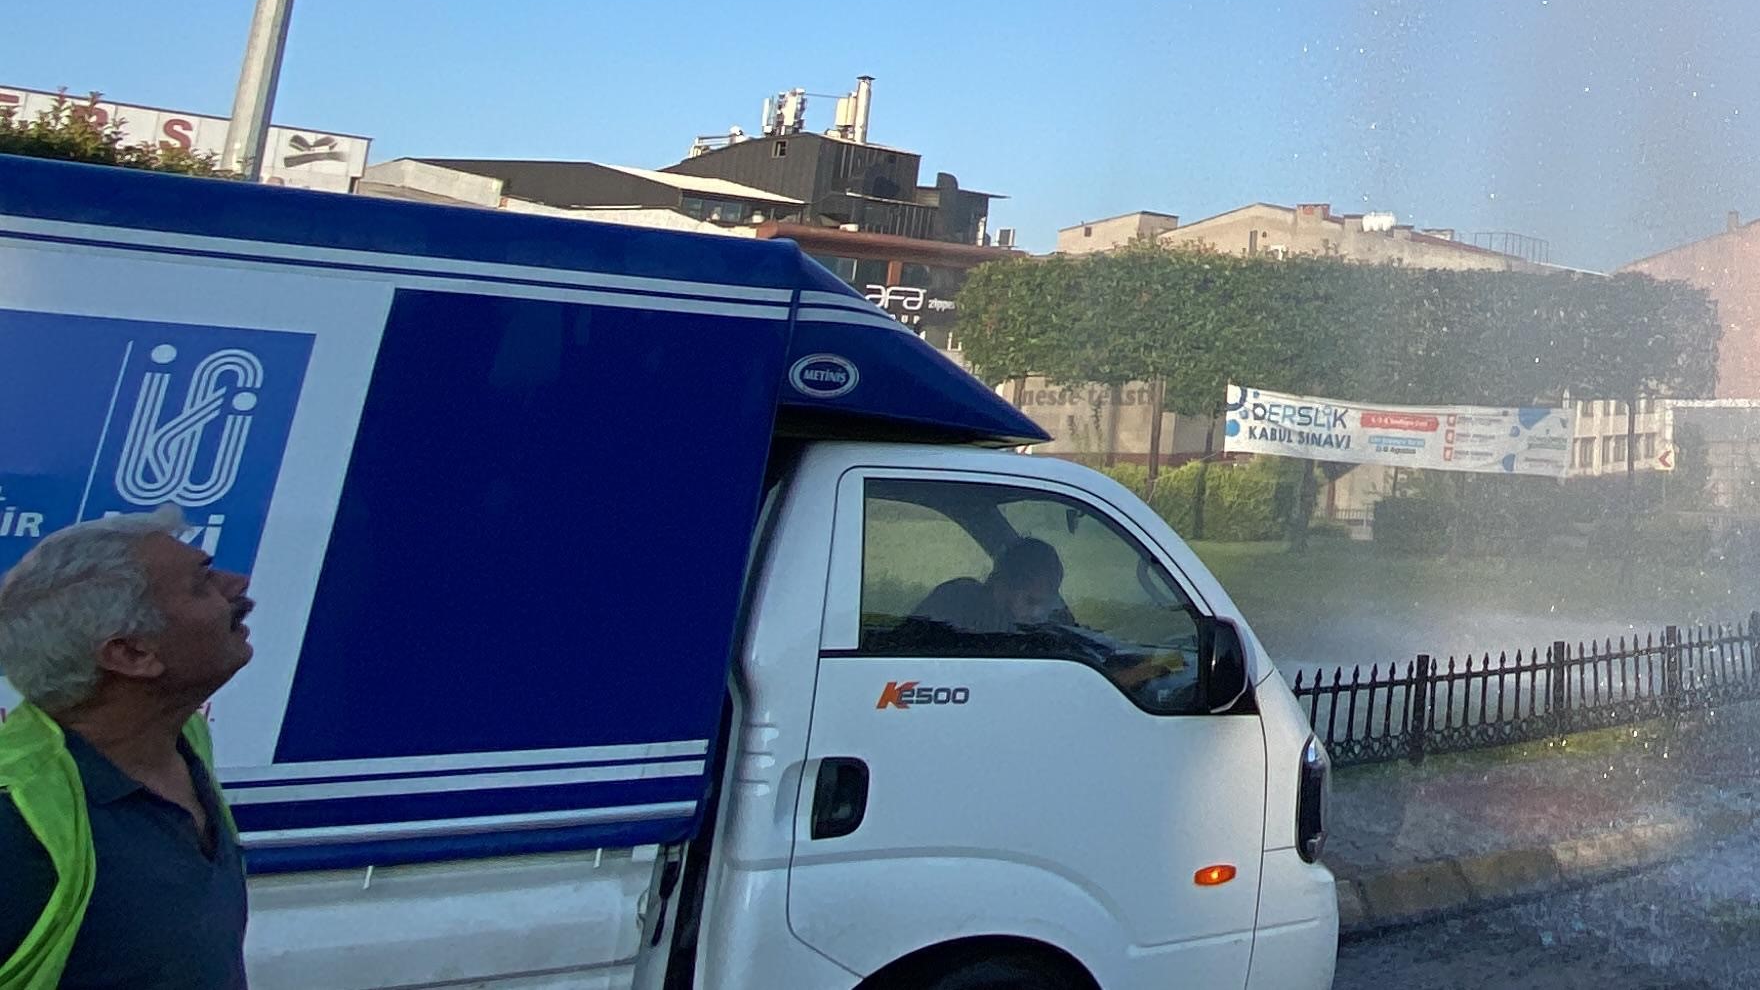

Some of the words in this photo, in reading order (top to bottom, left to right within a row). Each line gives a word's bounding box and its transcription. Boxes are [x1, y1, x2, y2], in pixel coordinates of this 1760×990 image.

[1248, 426, 1293, 443] KABUL
[1297, 431, 1352, 450] SINAVI
[876, 681, 970, 709] K2500
